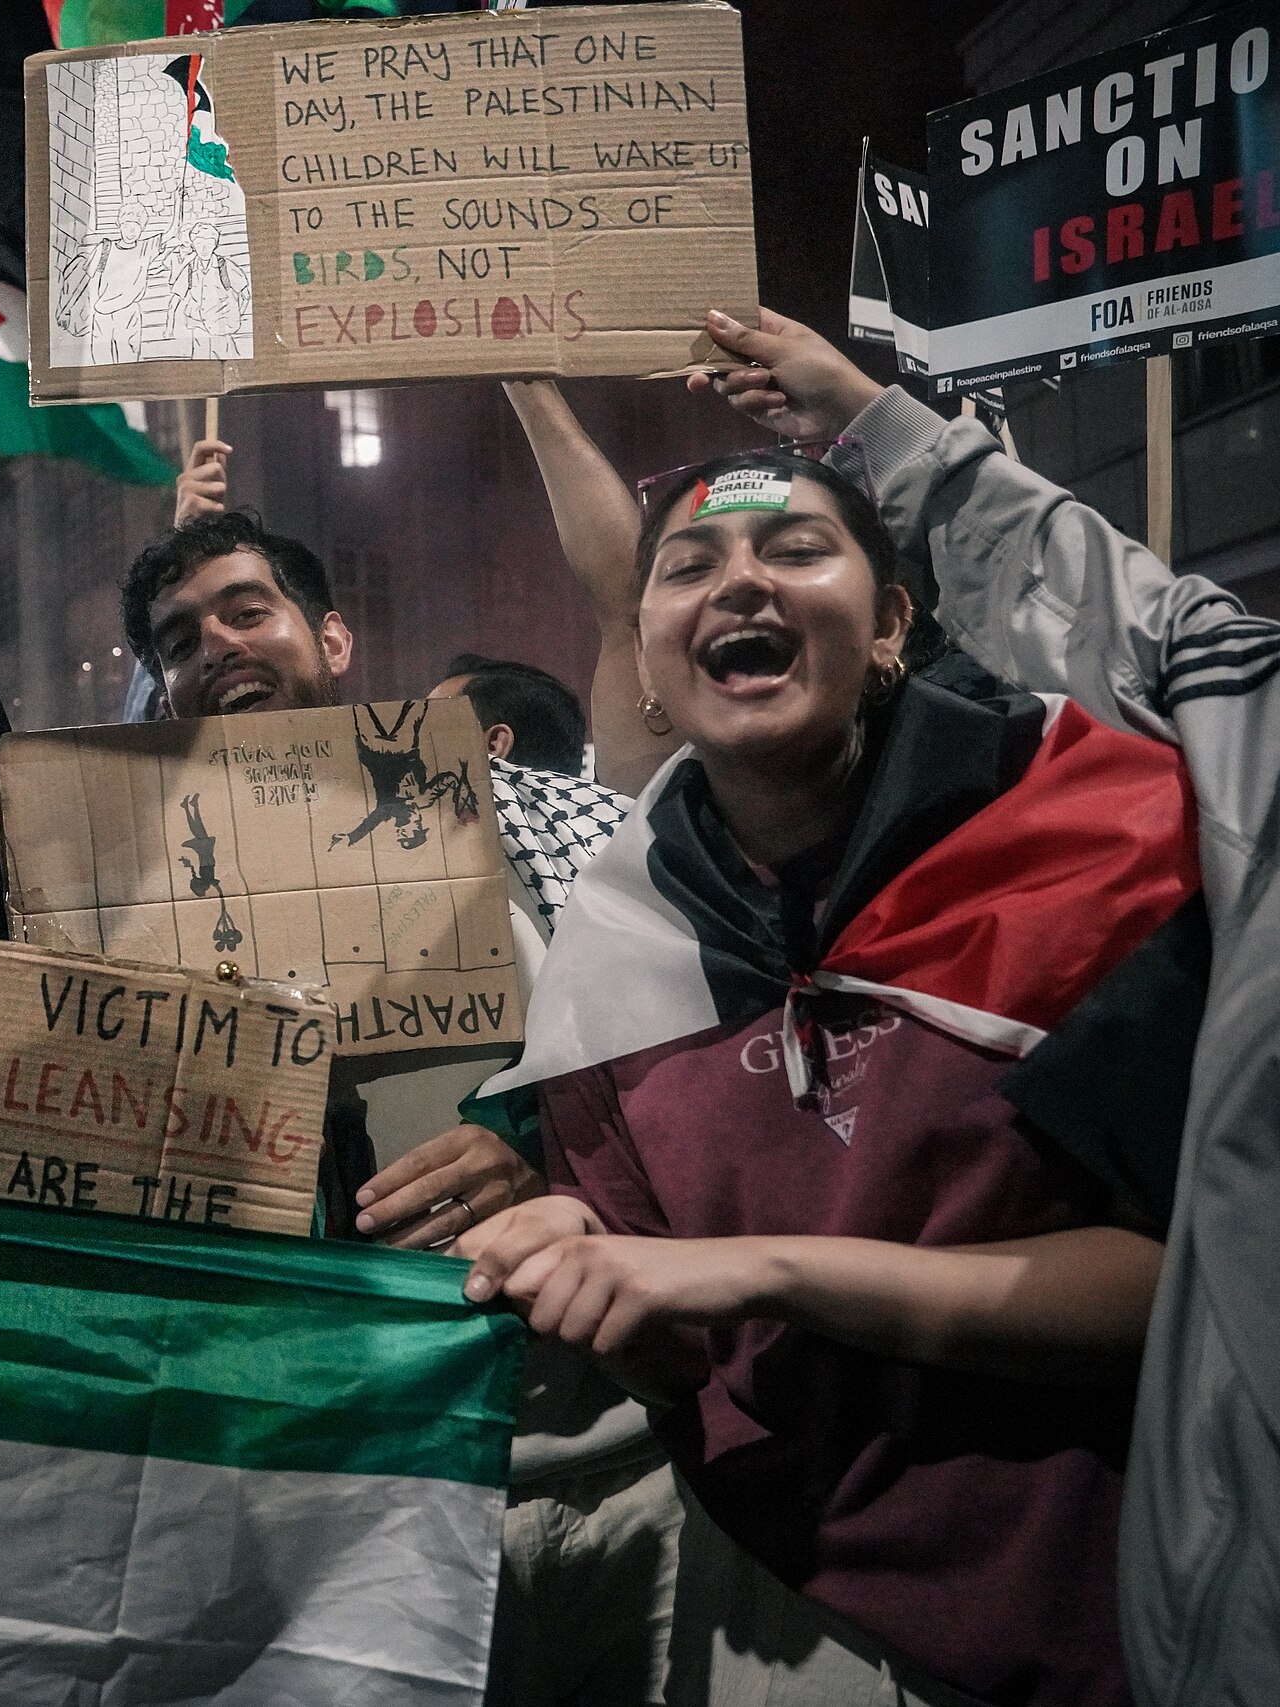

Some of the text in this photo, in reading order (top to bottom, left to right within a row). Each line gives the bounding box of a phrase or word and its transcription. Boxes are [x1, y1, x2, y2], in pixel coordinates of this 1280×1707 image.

[283, 34, 659, 86] WE PRAY THAT ONE
[285, 78, 716, 132] DAY, THE PALESTINIAN
[282, 140, 749, 184] CHILDREN WILL WAKE UP
[1105, 118, 1202, 197] ON
[290, 194, 675, 234] TO THE SOUNDS OF
[874, 172, 929, 229] SA
[1033, 169, 1280, 283] ISRAEL
[293, 245, 521, 287] BIRDS, NOT
[297, 289, 589, 348] EXPLOSIONS
[1090, 280, 1213, 332] FOA FRIENDS
[1147, 299, 1212, 320] OF AL-AQSA
[1197, 319, 1279, 341] friendsofalaqsa
[1080, 341, 1151, 363] friendsofalaqsa
[956, 363, 1042, 387] foapeaceinpalestine
[712, 482, 764, 495] ISRAELI
[715, 470, 776, 484] BOYCOTT
[708, 493, 785, 508] APARTHEID
[209, 746, 275, 766] WALLS
[251, 783, 319, 808] MAKE
[41, 974, 238, 1066] VICTIM
[266, 1003, 325, 1066] TO
[9, 1153, 98, 1211] ARE
[134, 1176, 237, 1226] THE
